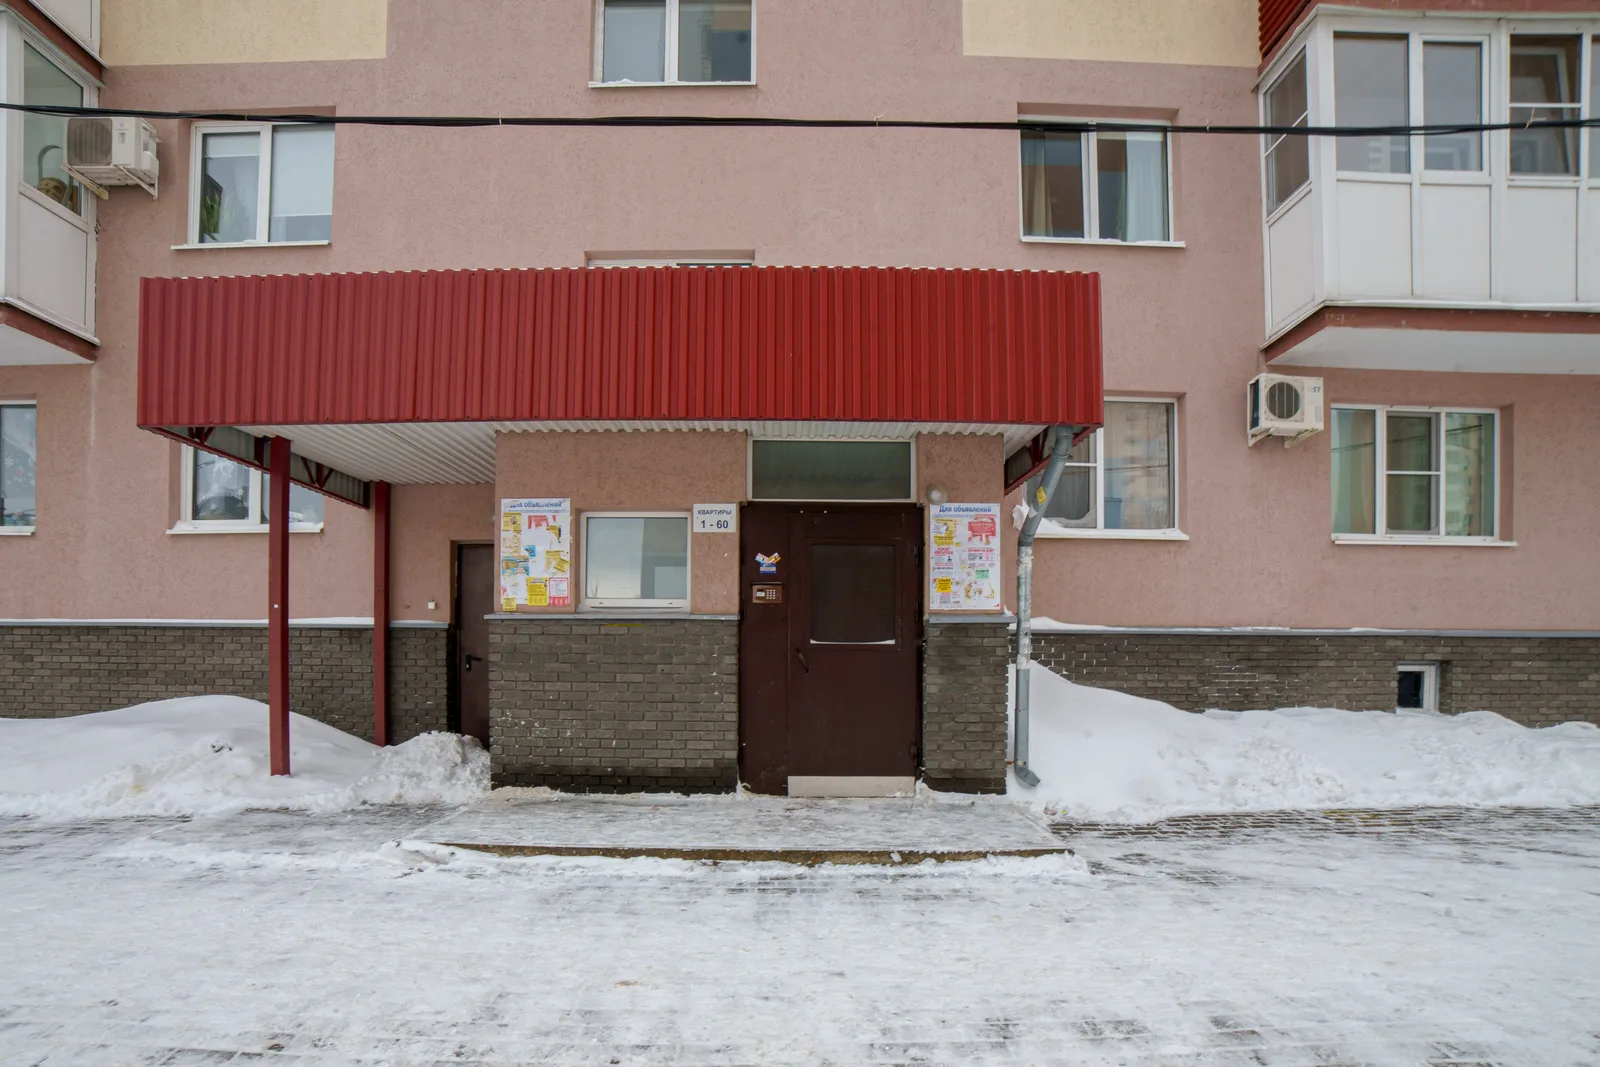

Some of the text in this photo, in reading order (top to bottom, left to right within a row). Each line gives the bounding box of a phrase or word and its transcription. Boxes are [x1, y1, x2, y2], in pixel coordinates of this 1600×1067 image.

[939, 505, 992, 513] Для объявлений
[701, 520, 706, 529] 1
[716, 520, 729, 529] 60
